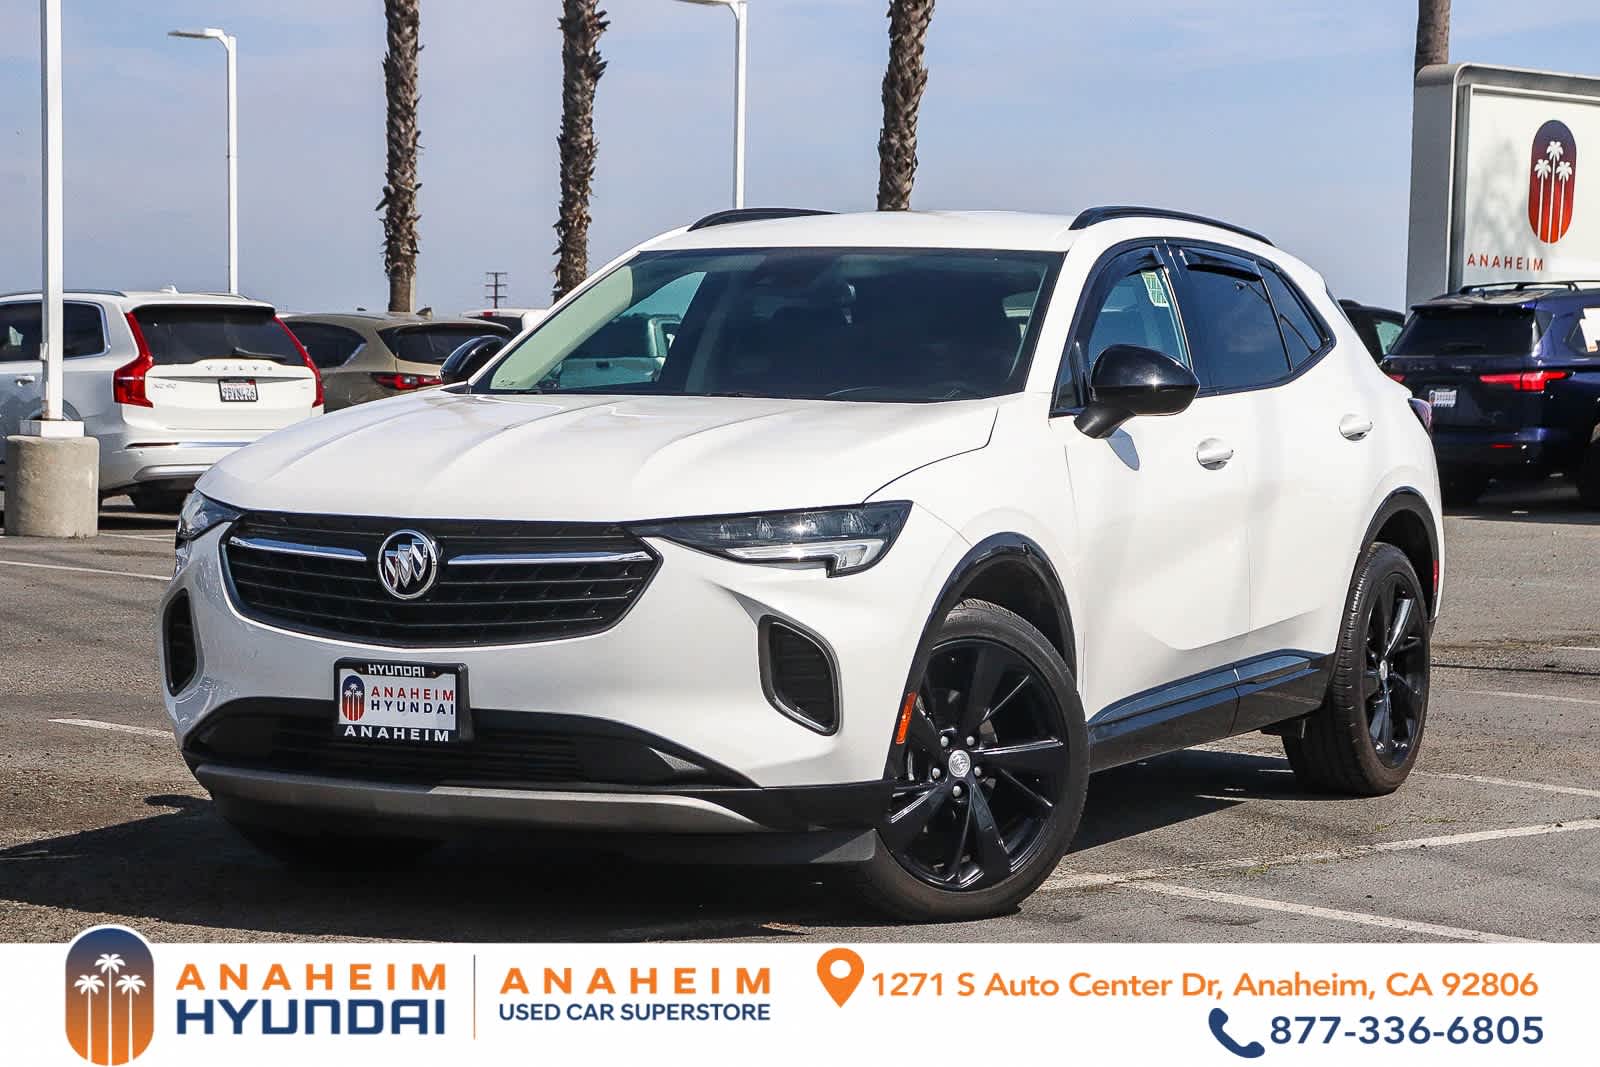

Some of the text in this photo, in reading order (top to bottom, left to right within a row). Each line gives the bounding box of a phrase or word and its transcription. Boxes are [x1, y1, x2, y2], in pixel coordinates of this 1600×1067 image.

[1467, 253, 1544, 271] ANAHEIM
[368, 664, 425, 676] HYUNDAI
[371, 686, 454, 702] ANAHEIM
[371, 700, 454, 715] HYUNDAI
[344, 725, 449, 742] ANAHEIM
